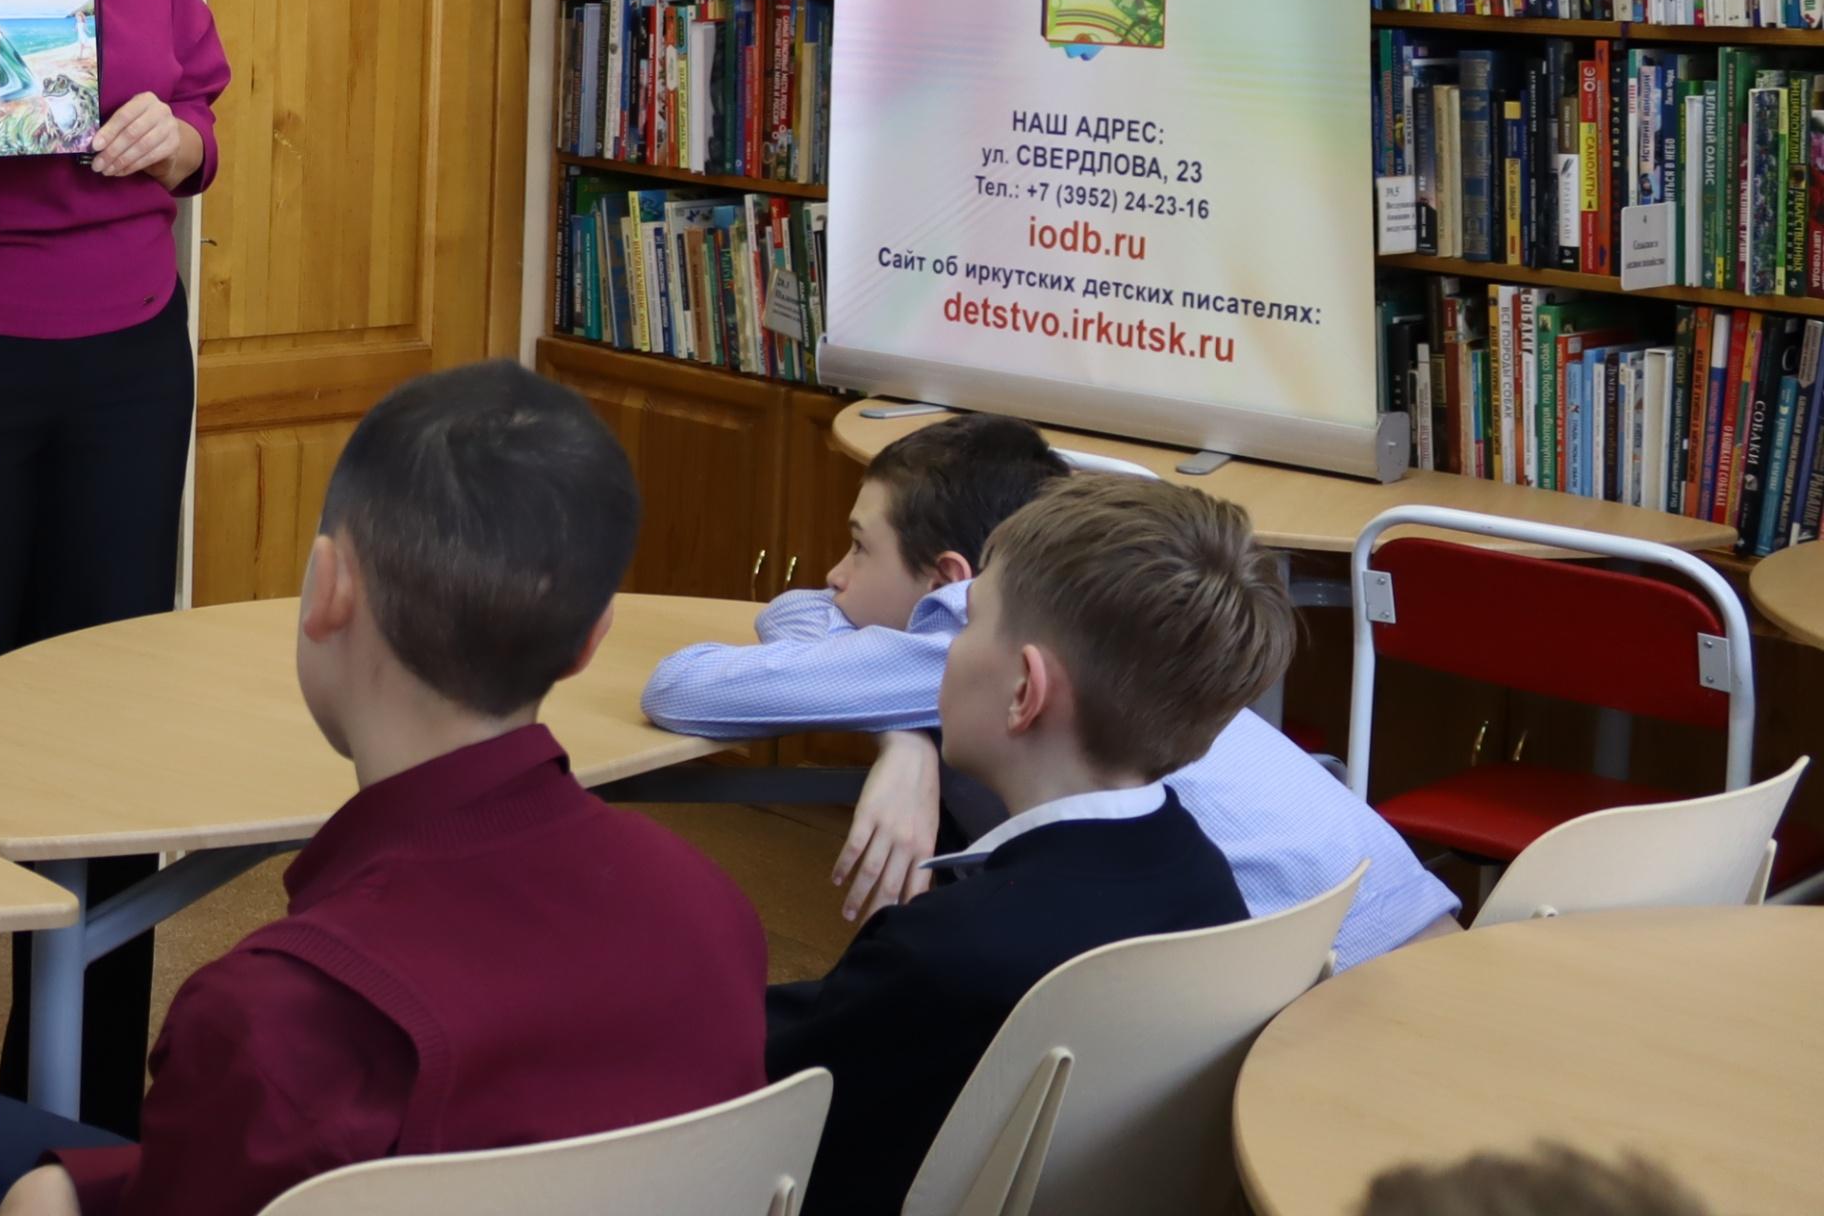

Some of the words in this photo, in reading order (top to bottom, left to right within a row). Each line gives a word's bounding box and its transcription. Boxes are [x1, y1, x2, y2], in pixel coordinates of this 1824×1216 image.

[1012, 110, 1068, 137] НАШ
[1076, 116, 1165, 146] АДРЕС:
[1705, 88, 1717, 143] ЗЕЛЕНЫЙ
[981, 147, 1010, 168] ул.
[1016, 145, 1169, 184] СВЕРДЛОВА,
[1177, 160, 1203, 184] 23
[1585, 136, 1596, 197] САМОЛЕТЫ
[1705, 145, 1716, 185] ОАЗИС
[975, 176, 1020, 199] Тел.:
[1026, 182, 1050, 203] +7
[1056, 183, 1118, 214] (3952)
[1125, 190, 1210, 220] 24-23-16
[1028, 216, 1147, 261] iodb.ru
[878, 247, 926, 273] Сайт
[932, 254, 959, 277] об
[965, 262, 1076, 294] иркутских
[1082, 279, 1175, 306] детских
[1182, 291, 1323, 325] писателях:
[943, 292, 1235, 363] detstvo.irkutsk.ru
[1502, 329, 1513, 378] ПОРОДЫ
[1503, 382, 1513, 419] СОБАК
[1746, 400, 1766, 465] СОБАКИ
